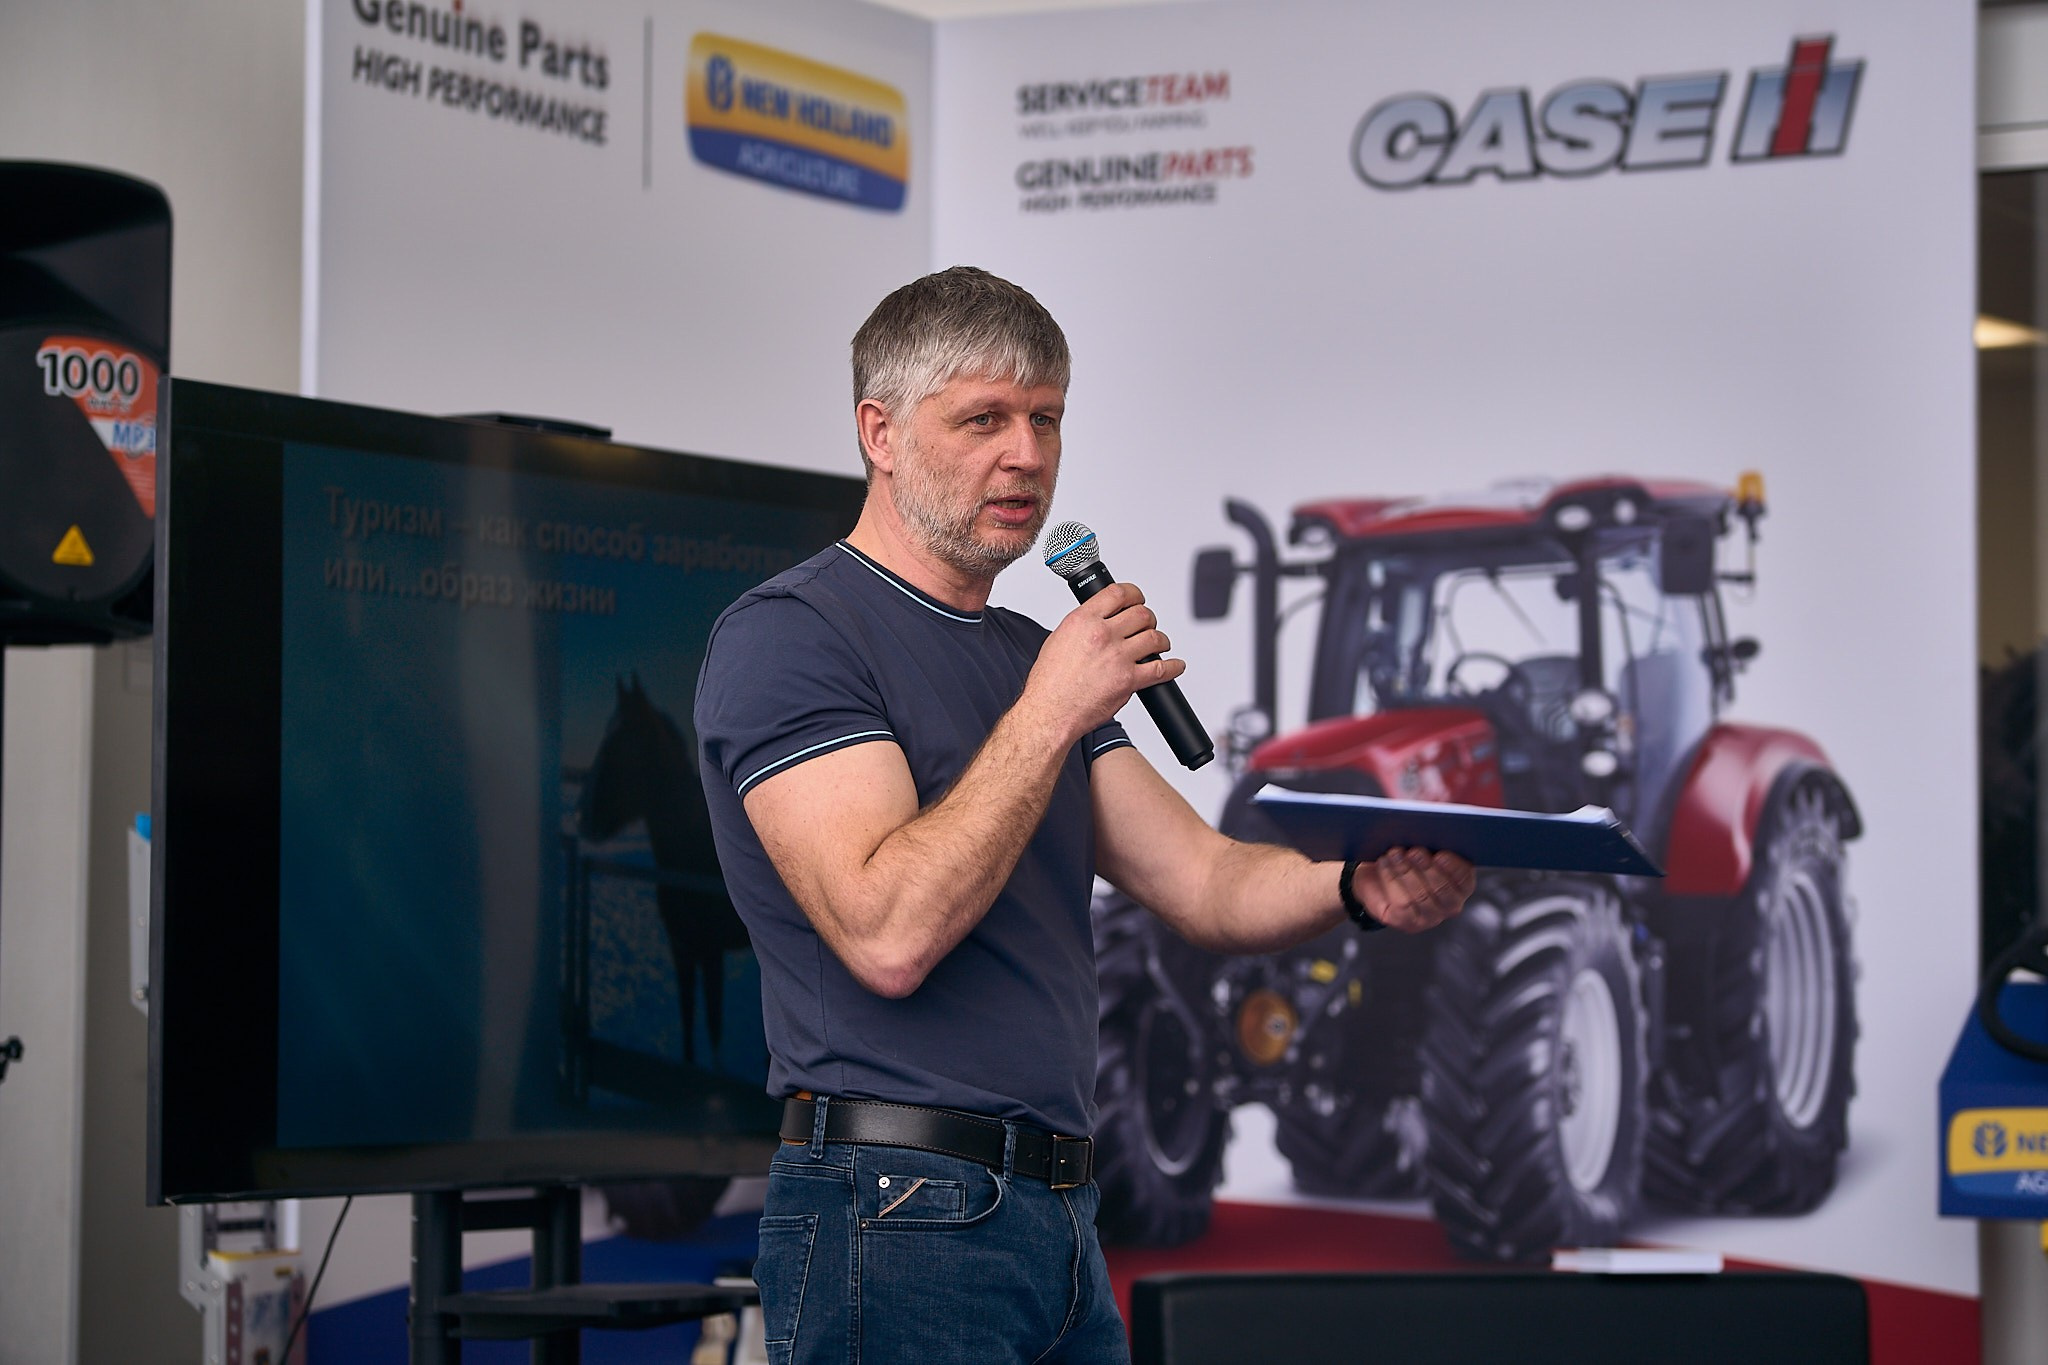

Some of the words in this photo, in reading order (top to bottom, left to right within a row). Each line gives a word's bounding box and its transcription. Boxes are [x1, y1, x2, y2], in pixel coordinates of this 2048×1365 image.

[519, 18, 609, 91] Parts
[354, 46, 422, 97] HIGH
[428, 66, 608, 147] PERFORMANCE
[741, 74, 790, 122] NEW
[797, 93, 893, 149] HOLLAND
[1351, 69, 1729, 192] CASE
[40, 347, 141, 396] 1000
[325, 486, 441, 539] Туризм
[480, 513, 524, 545] как
[537, 518, 643, 560] способ
[523, 580, 617, 615] жизни
[1077, 573, 1097, 588] SHURE
